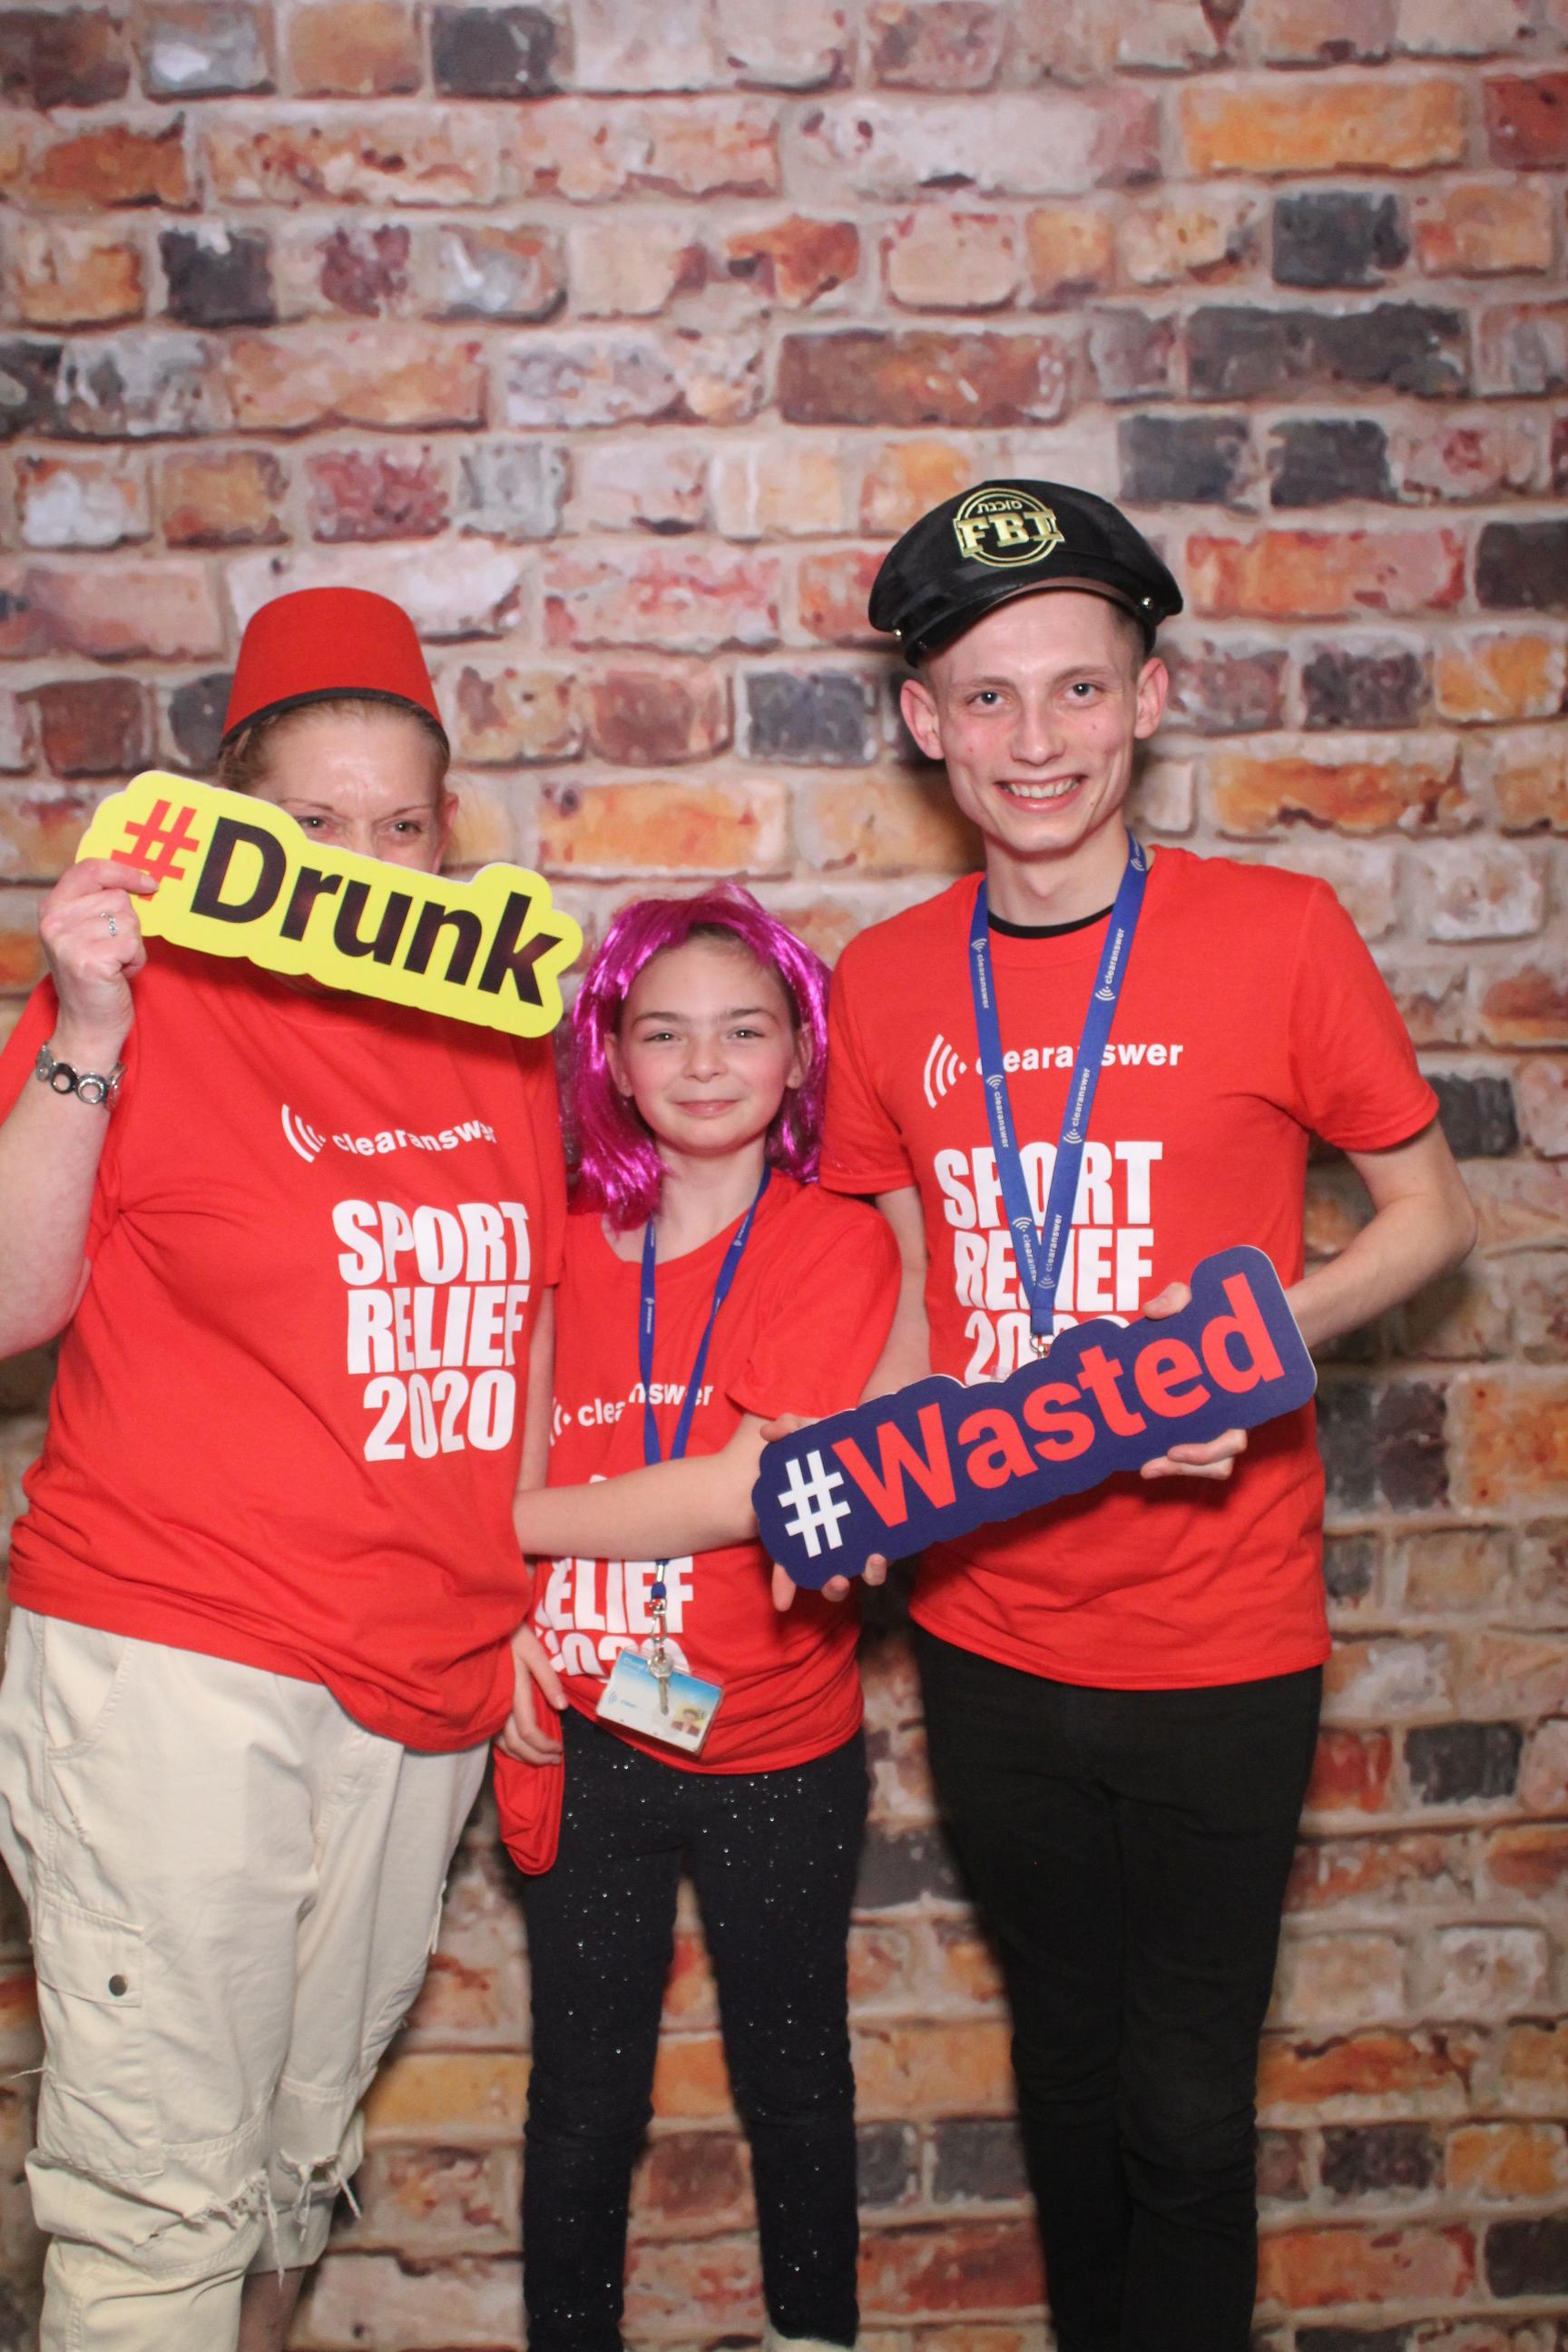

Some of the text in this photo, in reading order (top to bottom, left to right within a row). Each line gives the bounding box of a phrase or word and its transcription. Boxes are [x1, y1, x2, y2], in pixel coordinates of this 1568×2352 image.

[956, 508, 1063, 556] FBI
[111, 799, 564, 1007] #Drunk
[975, 953, 990, 1009] clearanswer
[1103, 927, 1125, 985] clearanswer
[975, 1044, 1183, 1076] earaswer
[1072, 1067, 1091, 1127] clearanswer
[332, 1120, 497, 1157] clearanswer
[994, 1091, 1009, 1148] clearanswer
[933, 1141, 1163, 1230] SPORT
[331, 1199, 532, 1287] SPORT
[954, 1228, 1154, 1312] REIEF
[347, 1285, 531, 1375] RELIEF
[964, 1310, 1131, 1387] 20
[363, 1368, 516, 1462] 2020
[777, 1271, 1285, 1559] #Wasted
[534, 1556, 694, 1634] ELIEF
